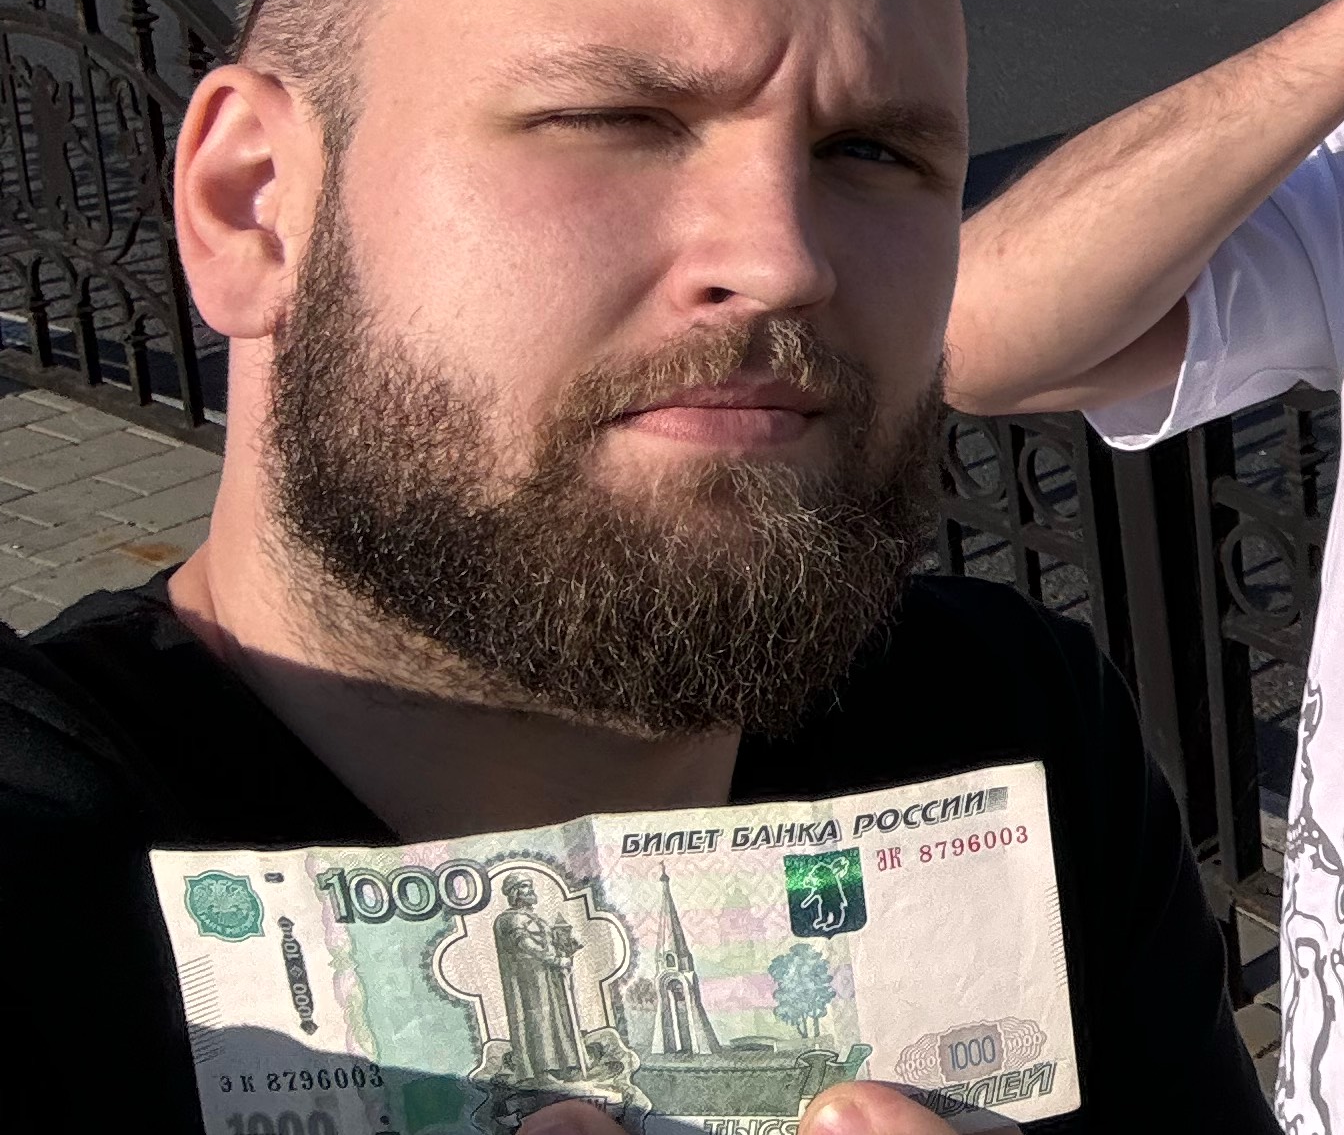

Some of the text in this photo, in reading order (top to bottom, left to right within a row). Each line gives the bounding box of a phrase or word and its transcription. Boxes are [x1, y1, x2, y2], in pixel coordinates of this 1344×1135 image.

[621, 788, 988, 857] БИЛЕТ БАНКА РОССИИ
[919, 825, 1029, 863] 8796003
[316, 858, 492, 924] 1000
[948, 1034, 996, 1071] 1000
[266, 1064, 385, 1092] 8796003
